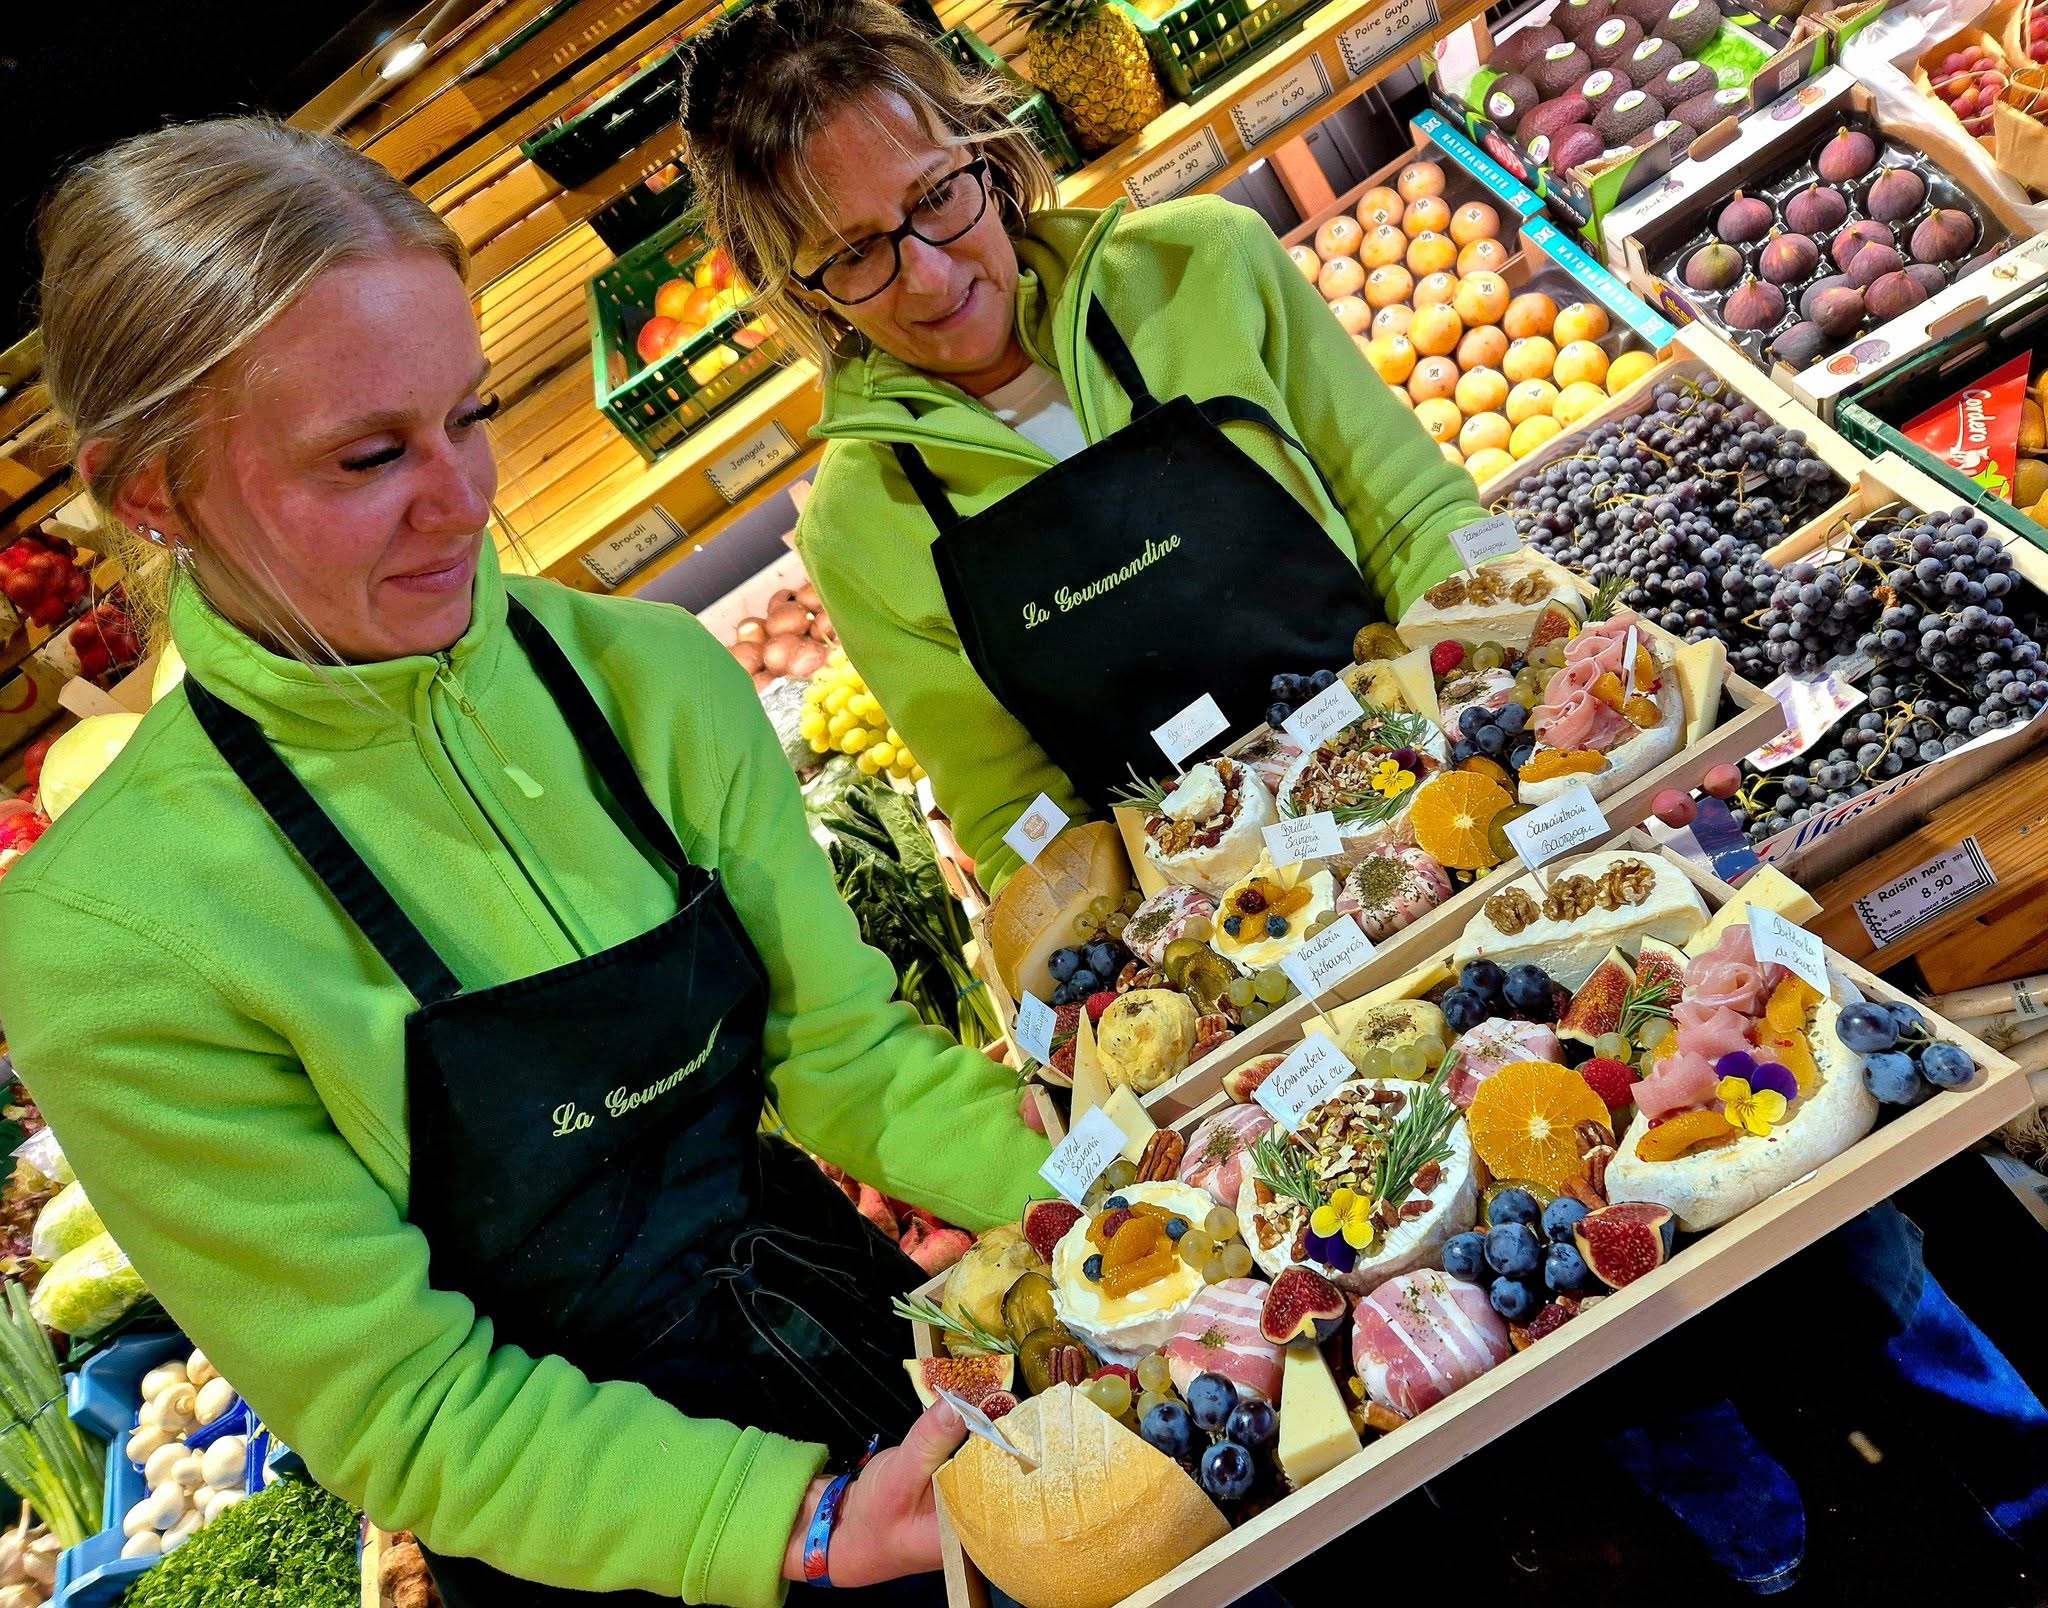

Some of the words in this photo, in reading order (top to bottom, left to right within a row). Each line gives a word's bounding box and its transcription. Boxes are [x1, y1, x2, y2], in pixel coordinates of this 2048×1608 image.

[1354, 15, 1382, 40] Poire
[1384, 15, 1411, 37] 3.20
[1255, 88, 1280, 107] Prunes
[1281, 86, 1305, 107] 6.90
[1141, 154, 1177, 186] Ananas
[1178, 139, 1203, 166] avion
[1174, 158, 1199, 180] 7.90
[1961, 388, 1997, 443] Cordero
[730, 441, 767, 471] Jonagold
[757, 449, 780, 468] 2.59
[610, 523, 647, 551] Brocoli
[635, 533, 659, 552] 2.99
[1022, 601, 1050, 630] La
[1054, 534, 1181, 613] Gourmandine
[1877, 875, 1919, 903] Raisin
[1921, 858, 1948, 881] noir
[1921, 874, 1953, 900] 8.90
[552, 1102, 595, 1137] La
